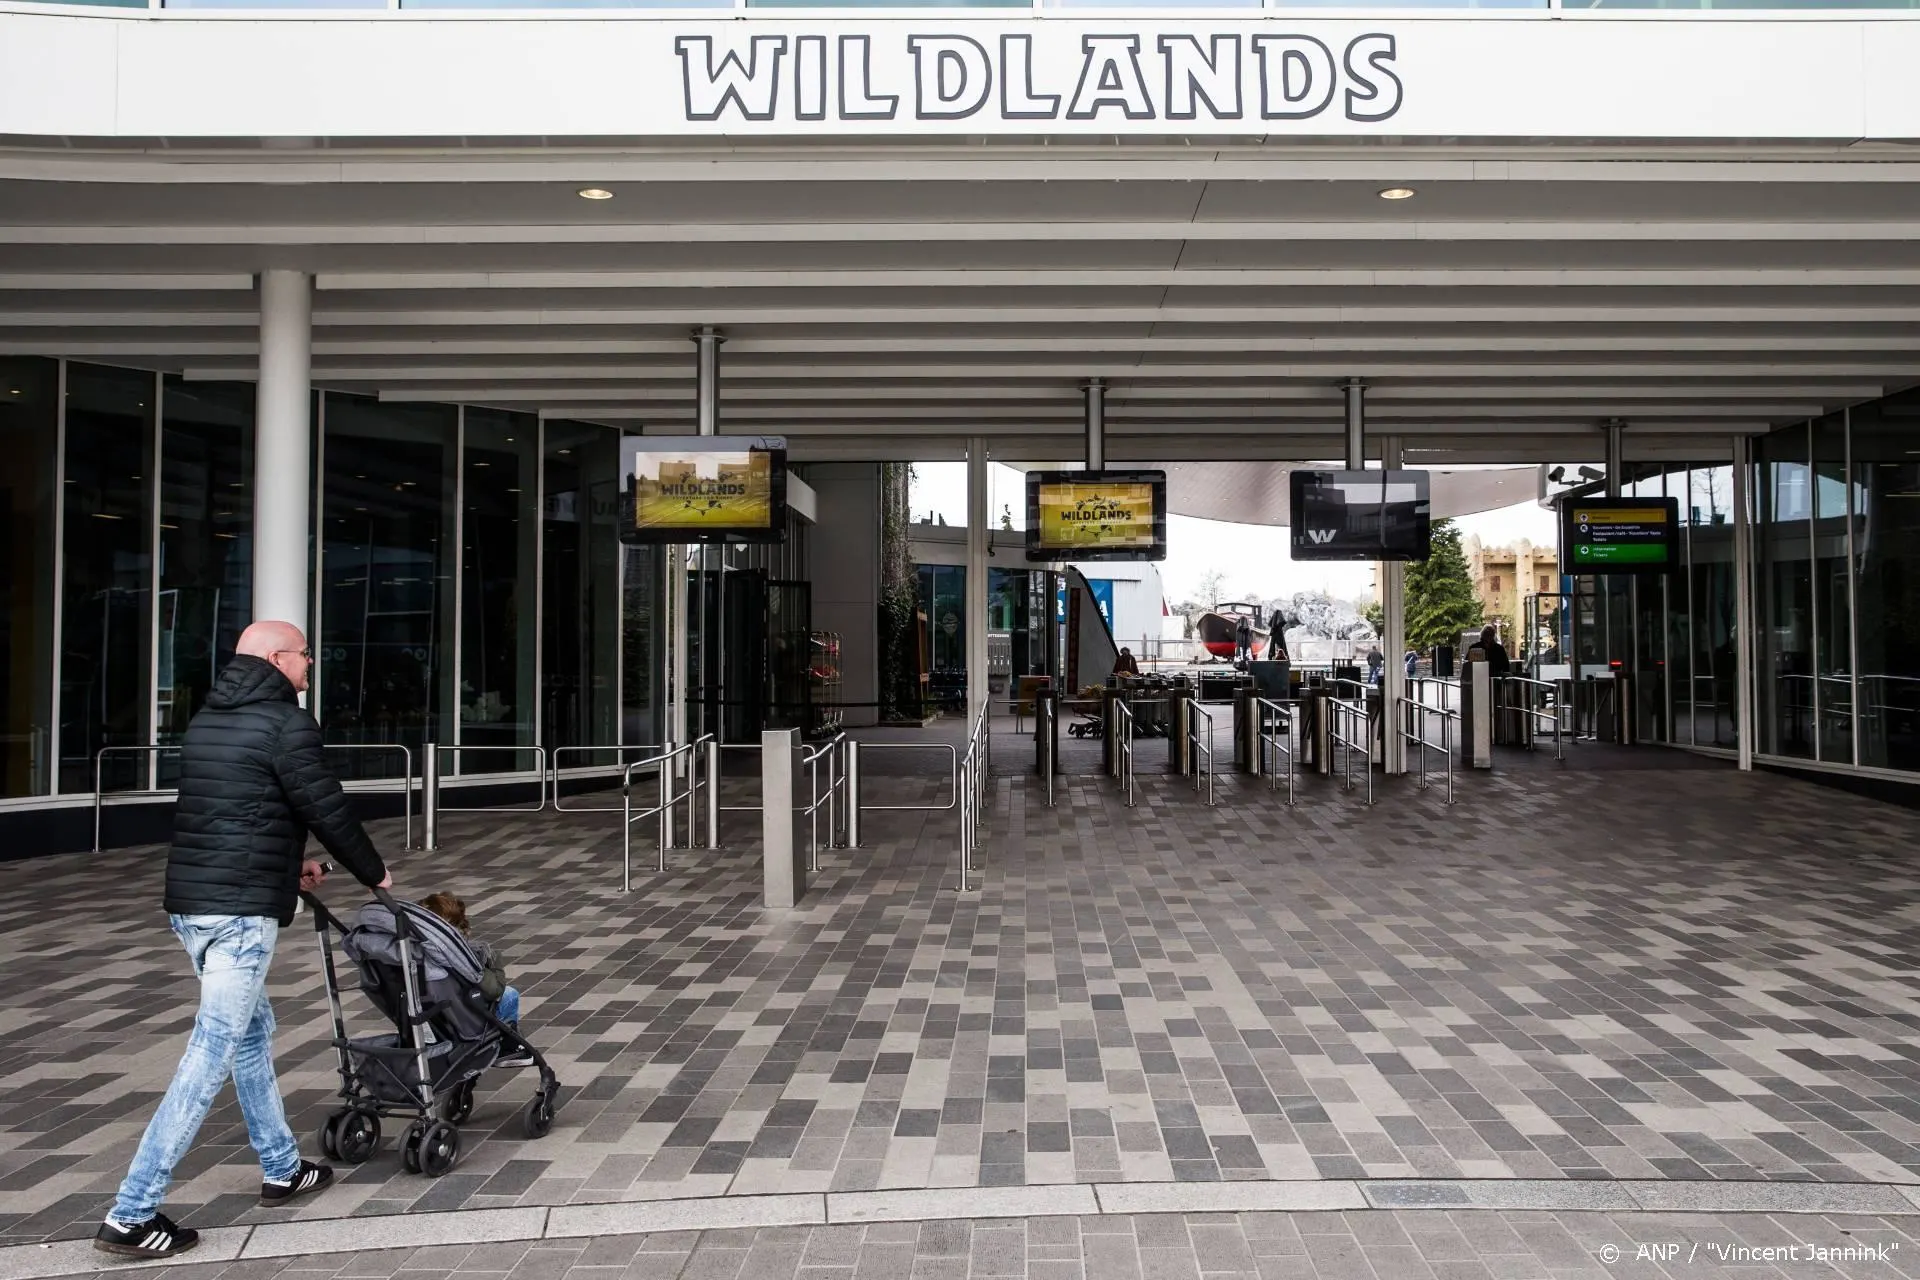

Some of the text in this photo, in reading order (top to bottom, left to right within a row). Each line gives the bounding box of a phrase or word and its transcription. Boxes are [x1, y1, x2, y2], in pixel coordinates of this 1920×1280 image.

[675, 34, 1403, 122] WILDLANDS
[661, 483, 746, 496] WILDLANDS
[1060, 510, 1132, 521] WILDLANDS
[1307, 529, 1337, 544] W
